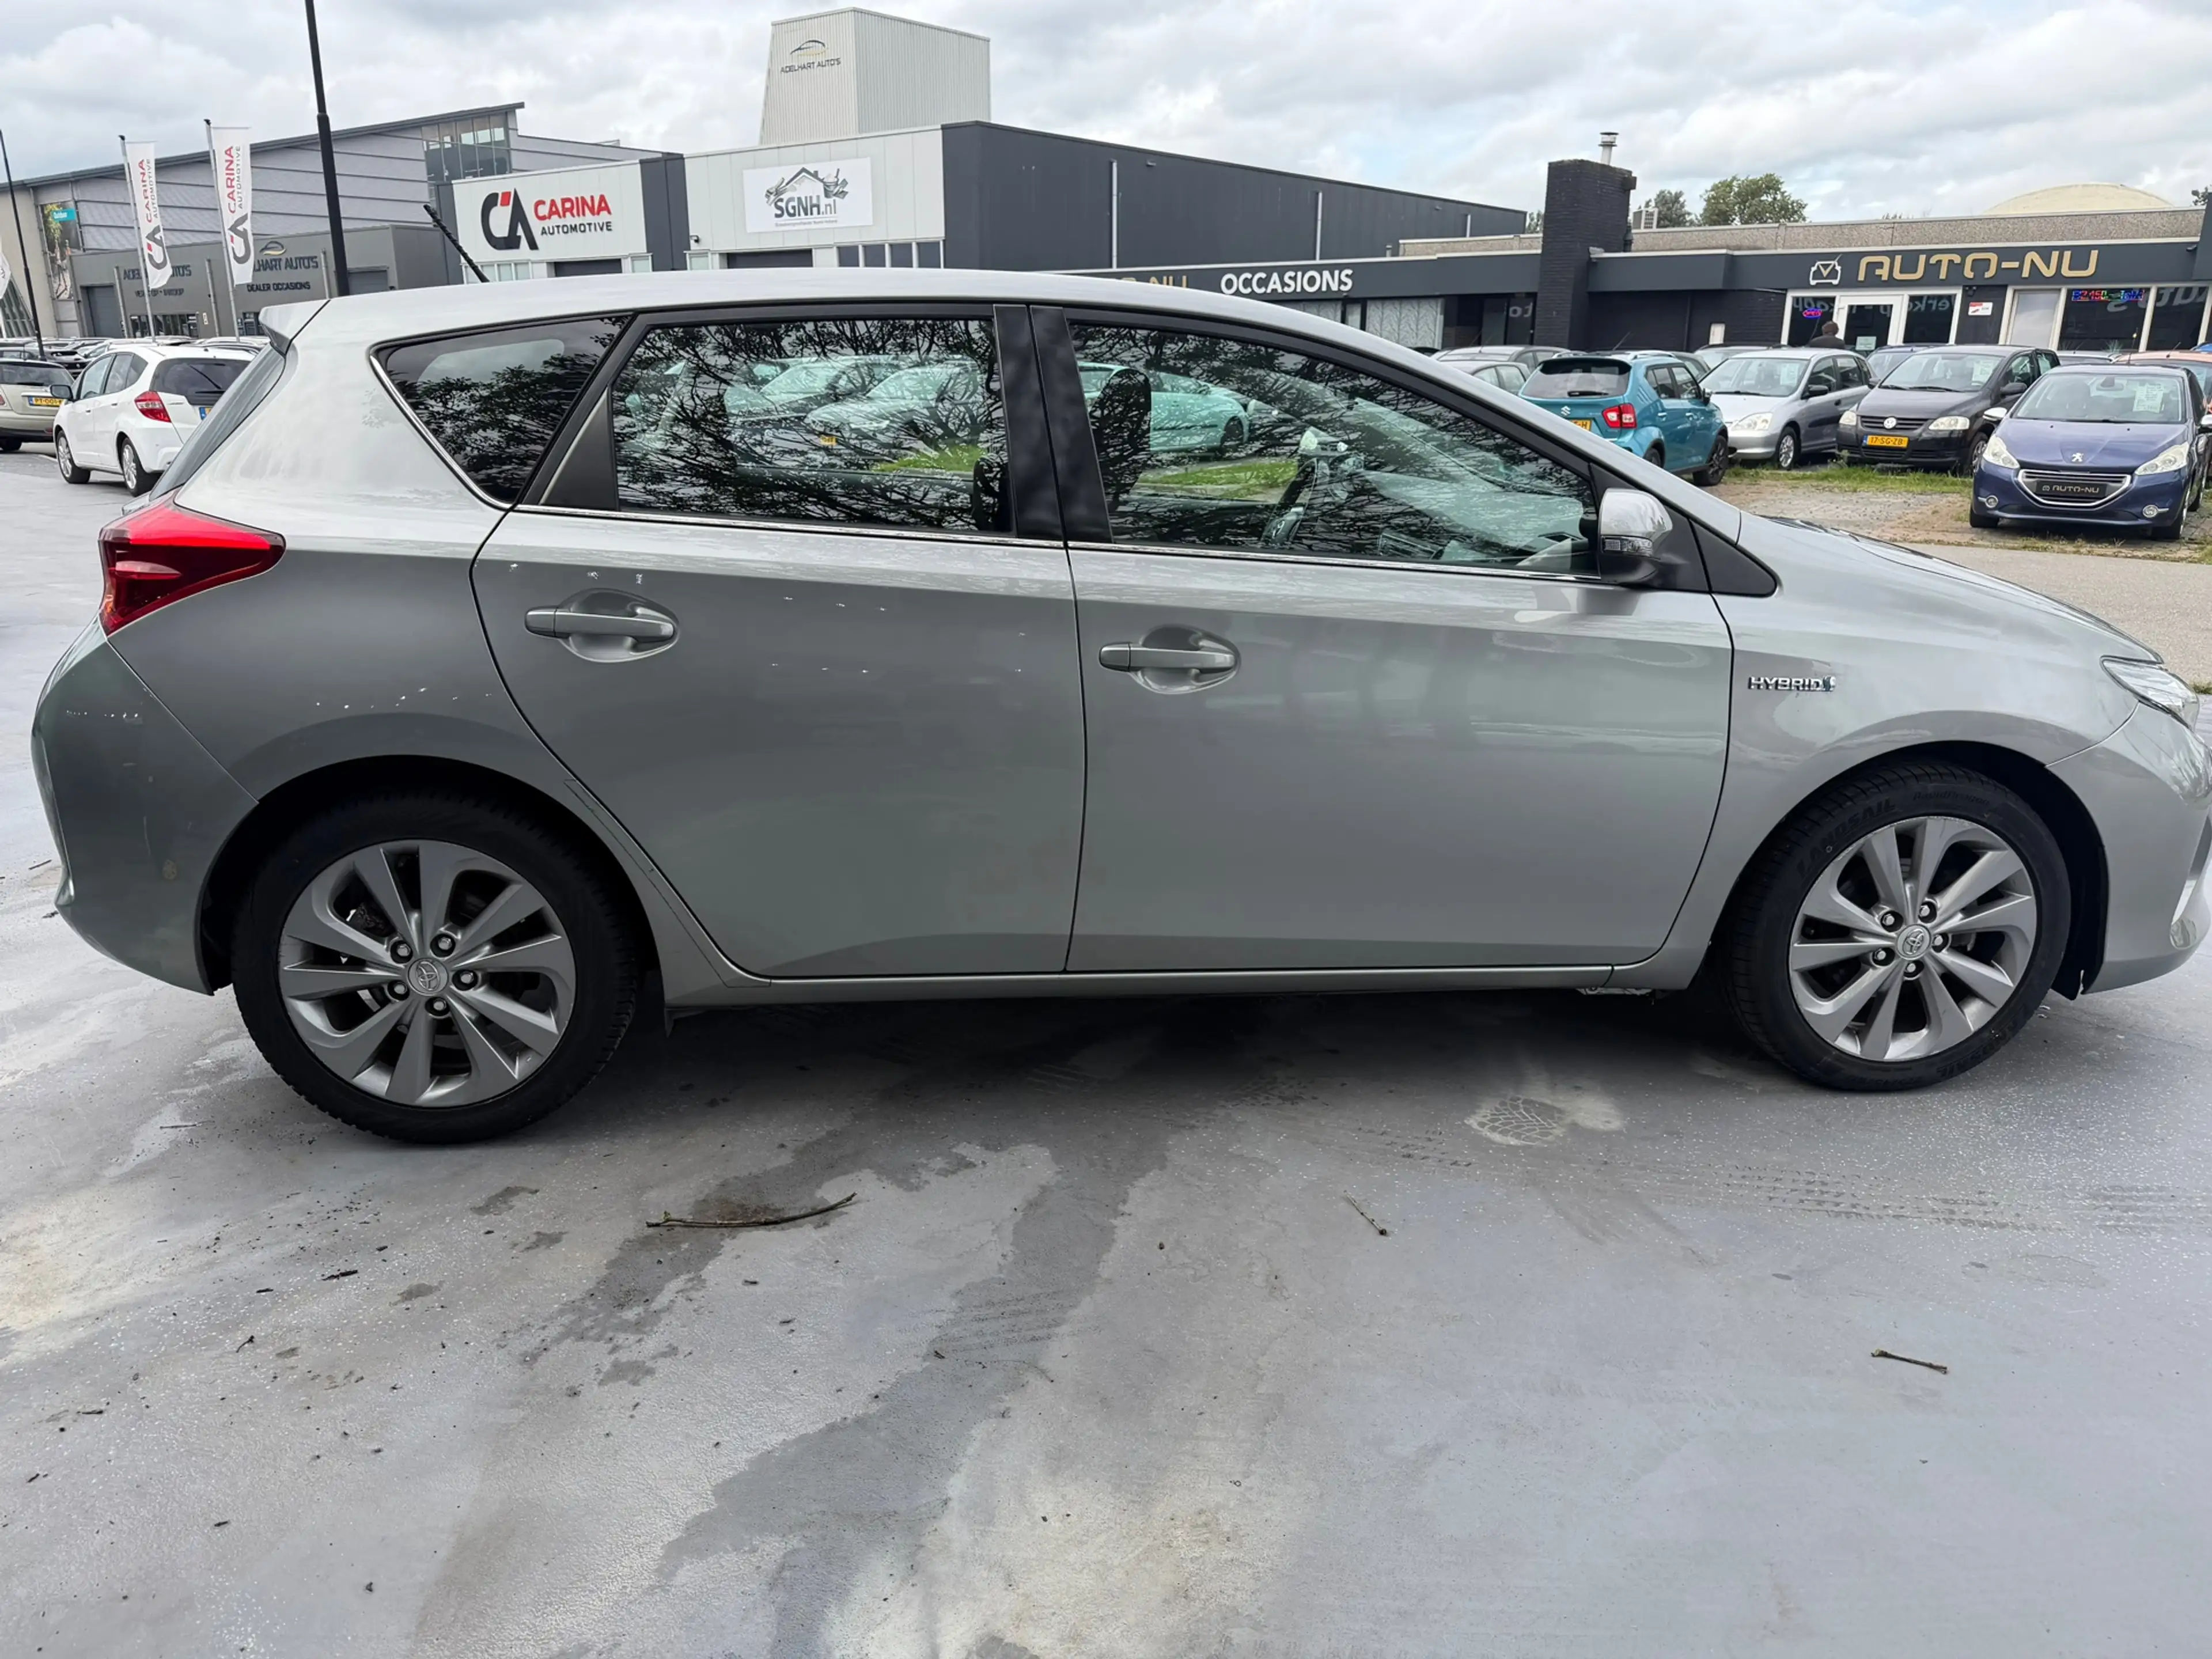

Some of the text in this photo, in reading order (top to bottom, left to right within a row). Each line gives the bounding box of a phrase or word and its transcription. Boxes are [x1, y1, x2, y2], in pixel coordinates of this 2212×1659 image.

[138, 159, 152, 223] CARINA
[145, 159, 158, 218] AUTOMOTIVE
[224, 146, 236, 214] CARINA
[533, 194, 612, 221] CARINA
[774, 195, 836, 218] SGNH.nl
[540, 221, 612, 236] AUTOMOTIVE
[1857, 249, 2099, 281] AUTO-NU
[247, 283, 271, 293] DEALER
[1220, 268, 1354, 295] OCCASIONS
[2052, 485, 2100, 493] AUTO-NU
[1748, 676, 1823, 692] HYBRID
